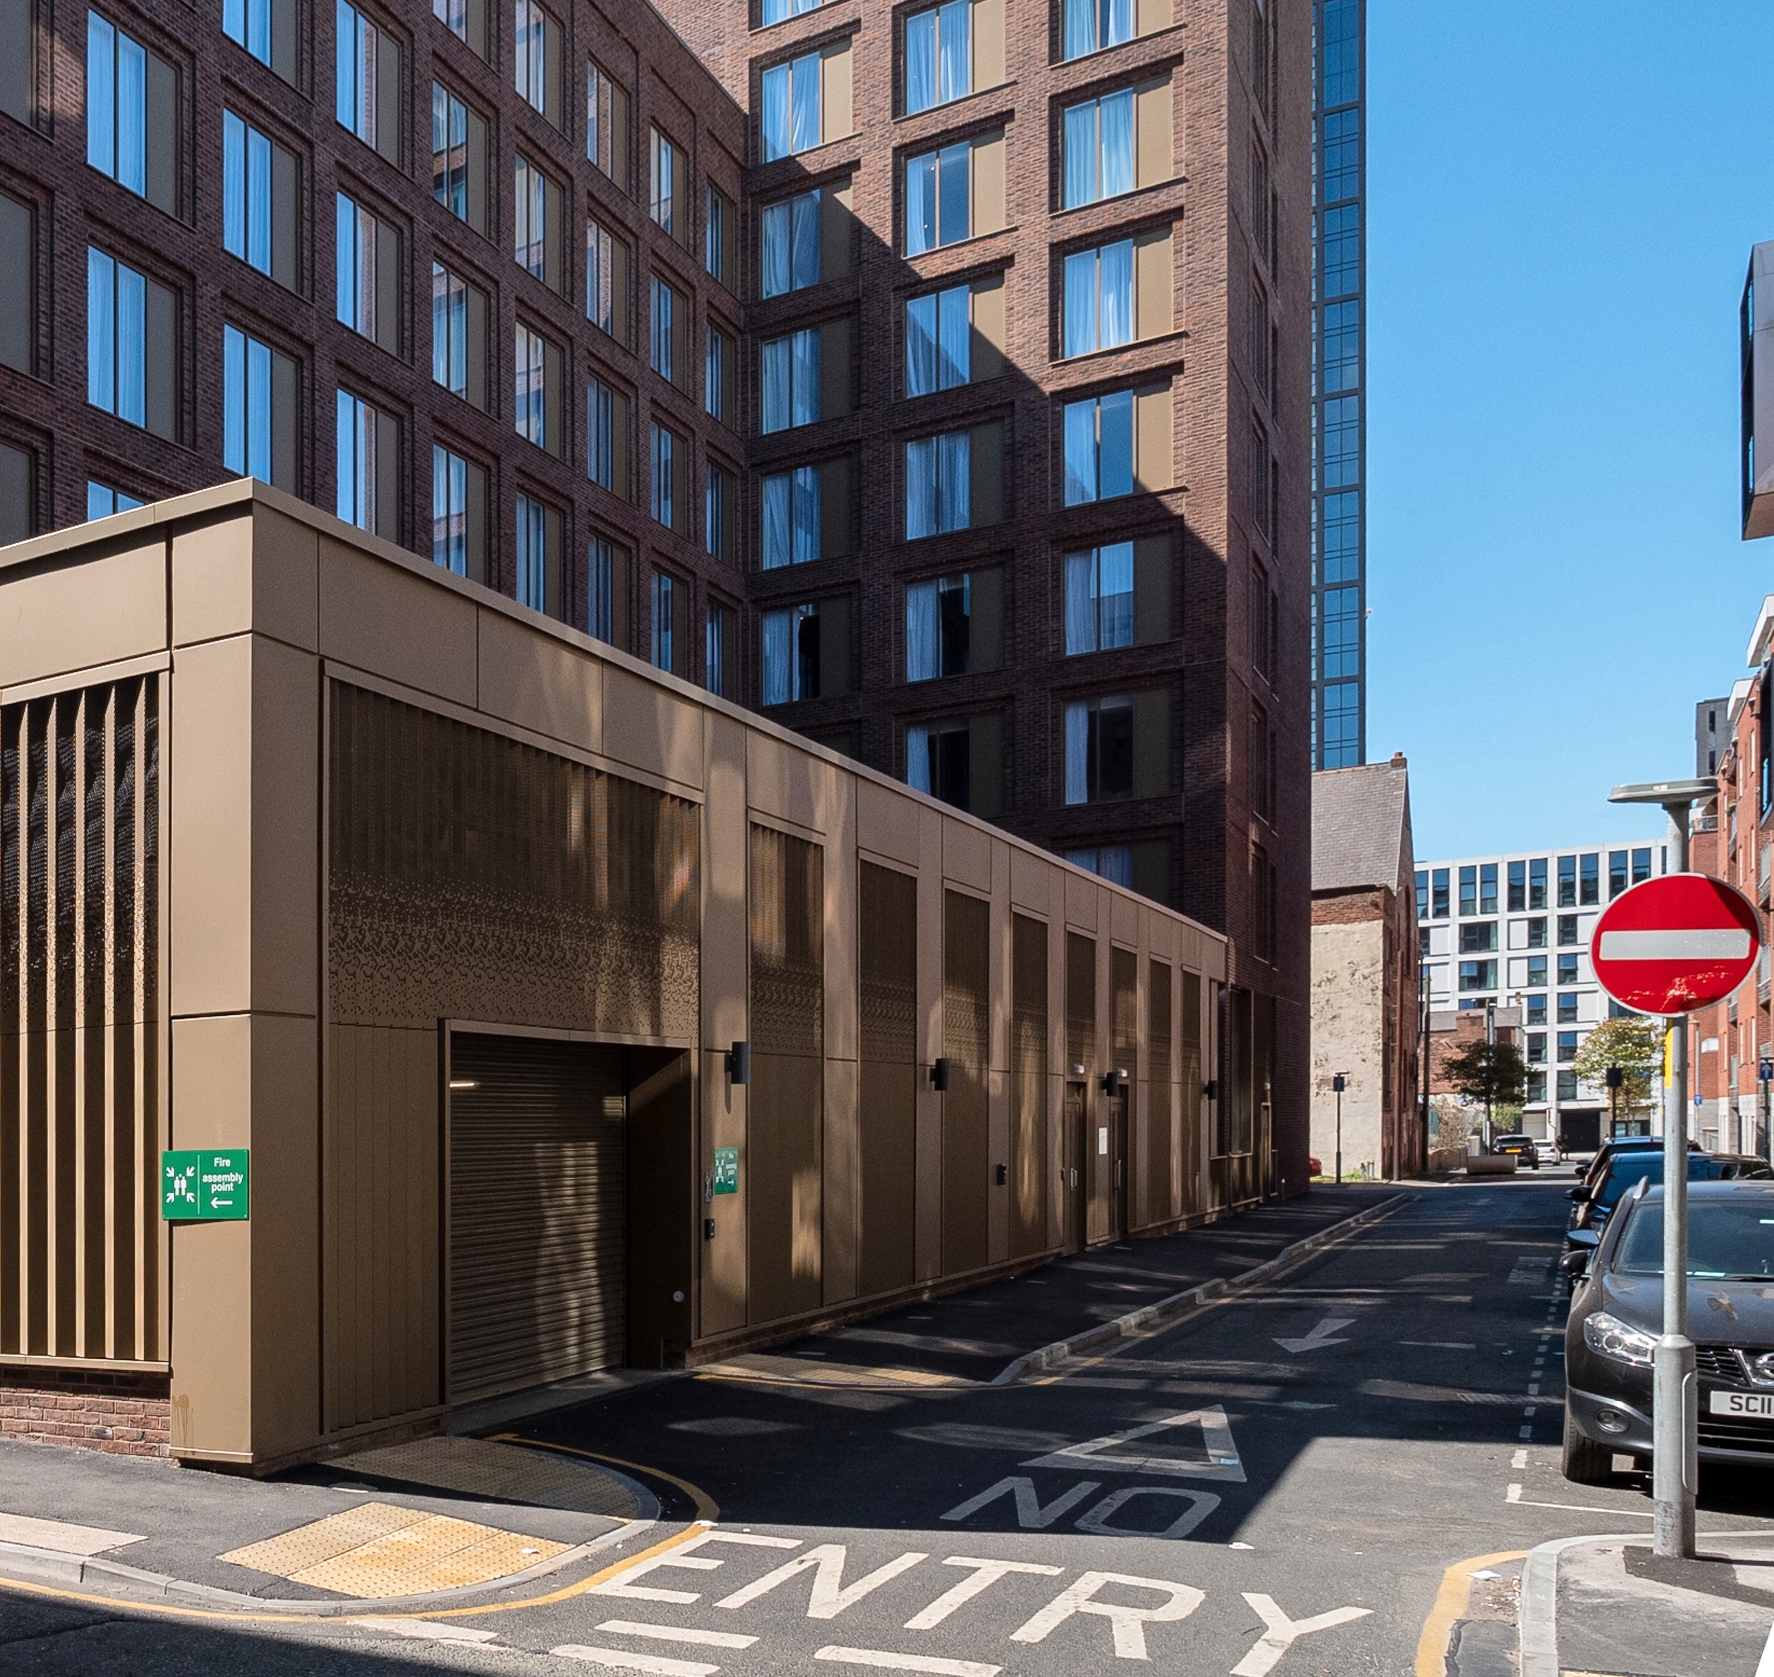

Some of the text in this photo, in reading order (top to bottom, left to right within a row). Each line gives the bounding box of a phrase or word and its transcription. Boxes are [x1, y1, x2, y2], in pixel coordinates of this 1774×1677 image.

[213, 1157, 231, 1167] Fire
[202, 1172, 244, 1184] assembly
[211, 1182, 234, 1194] point
[939, 1476, 1222, 1539] NO
[586, 1530, 1375, 1677] ENTRY
